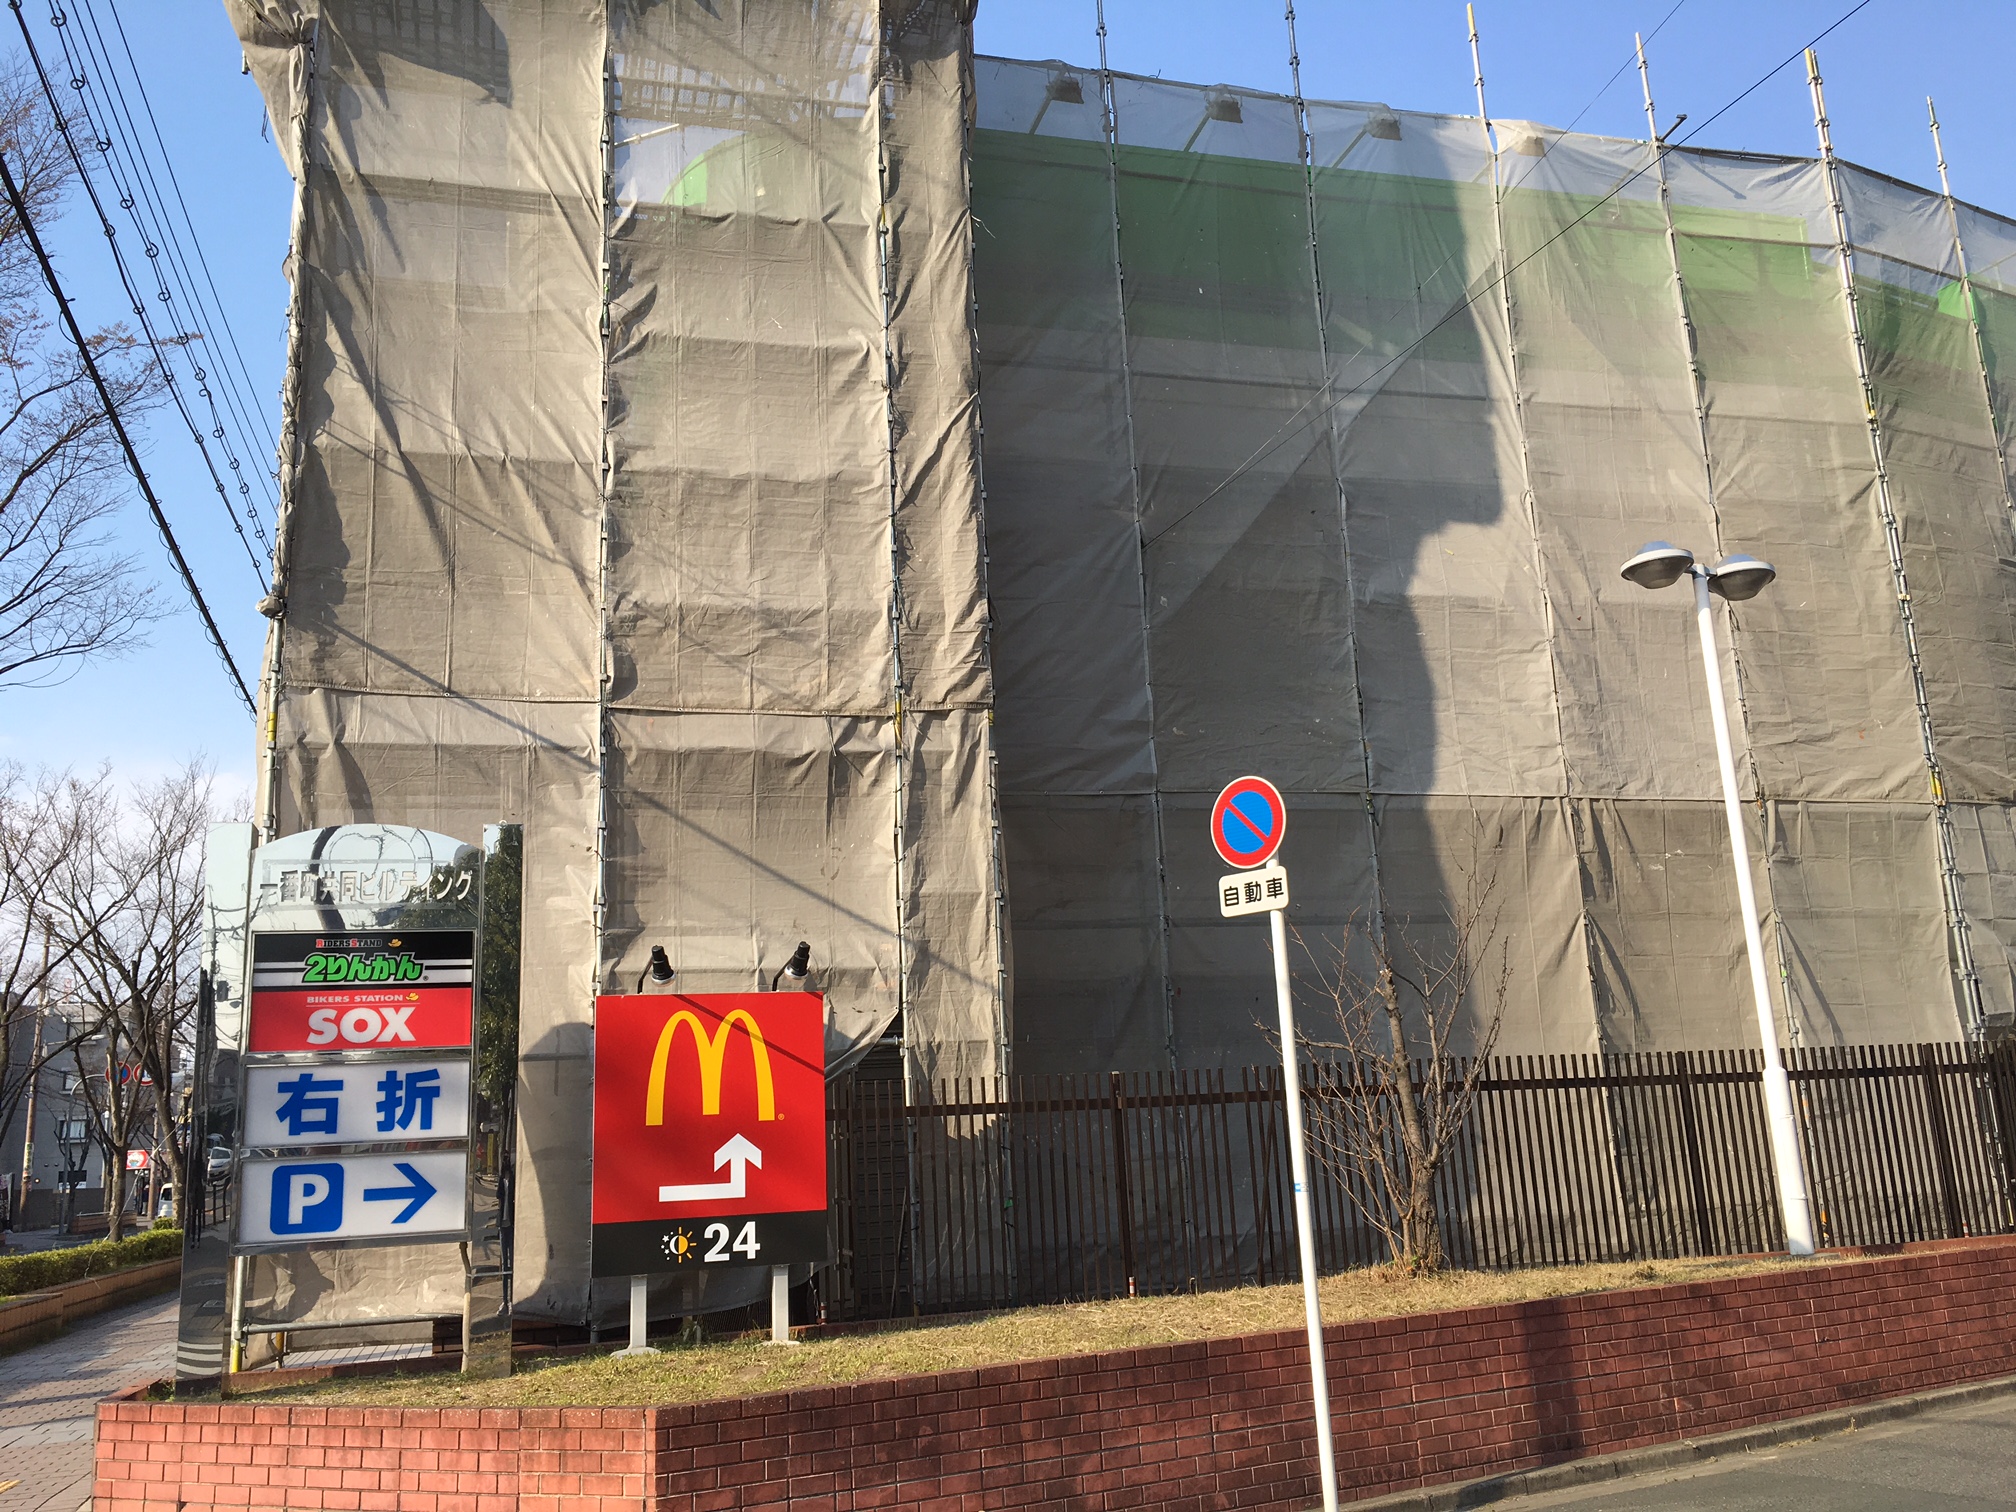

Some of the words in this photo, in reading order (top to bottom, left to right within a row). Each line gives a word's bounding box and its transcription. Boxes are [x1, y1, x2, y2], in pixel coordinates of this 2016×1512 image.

[259, 869, 473, 903] 一番町共同ビルディング
[1223, 877, 1284, 907] 自動車
[302, 952, 424, 983] 2りんかん
[307, 996, 350, 1004] BIKERS
[354, 994, 403, 1003] STATION
[306, 1006, 416, 1045] SOX
[275, 1068, 441, 1136] 右折
[288, 1173, 330, 1225] P
[703, 1220, 761, 1263] 24
